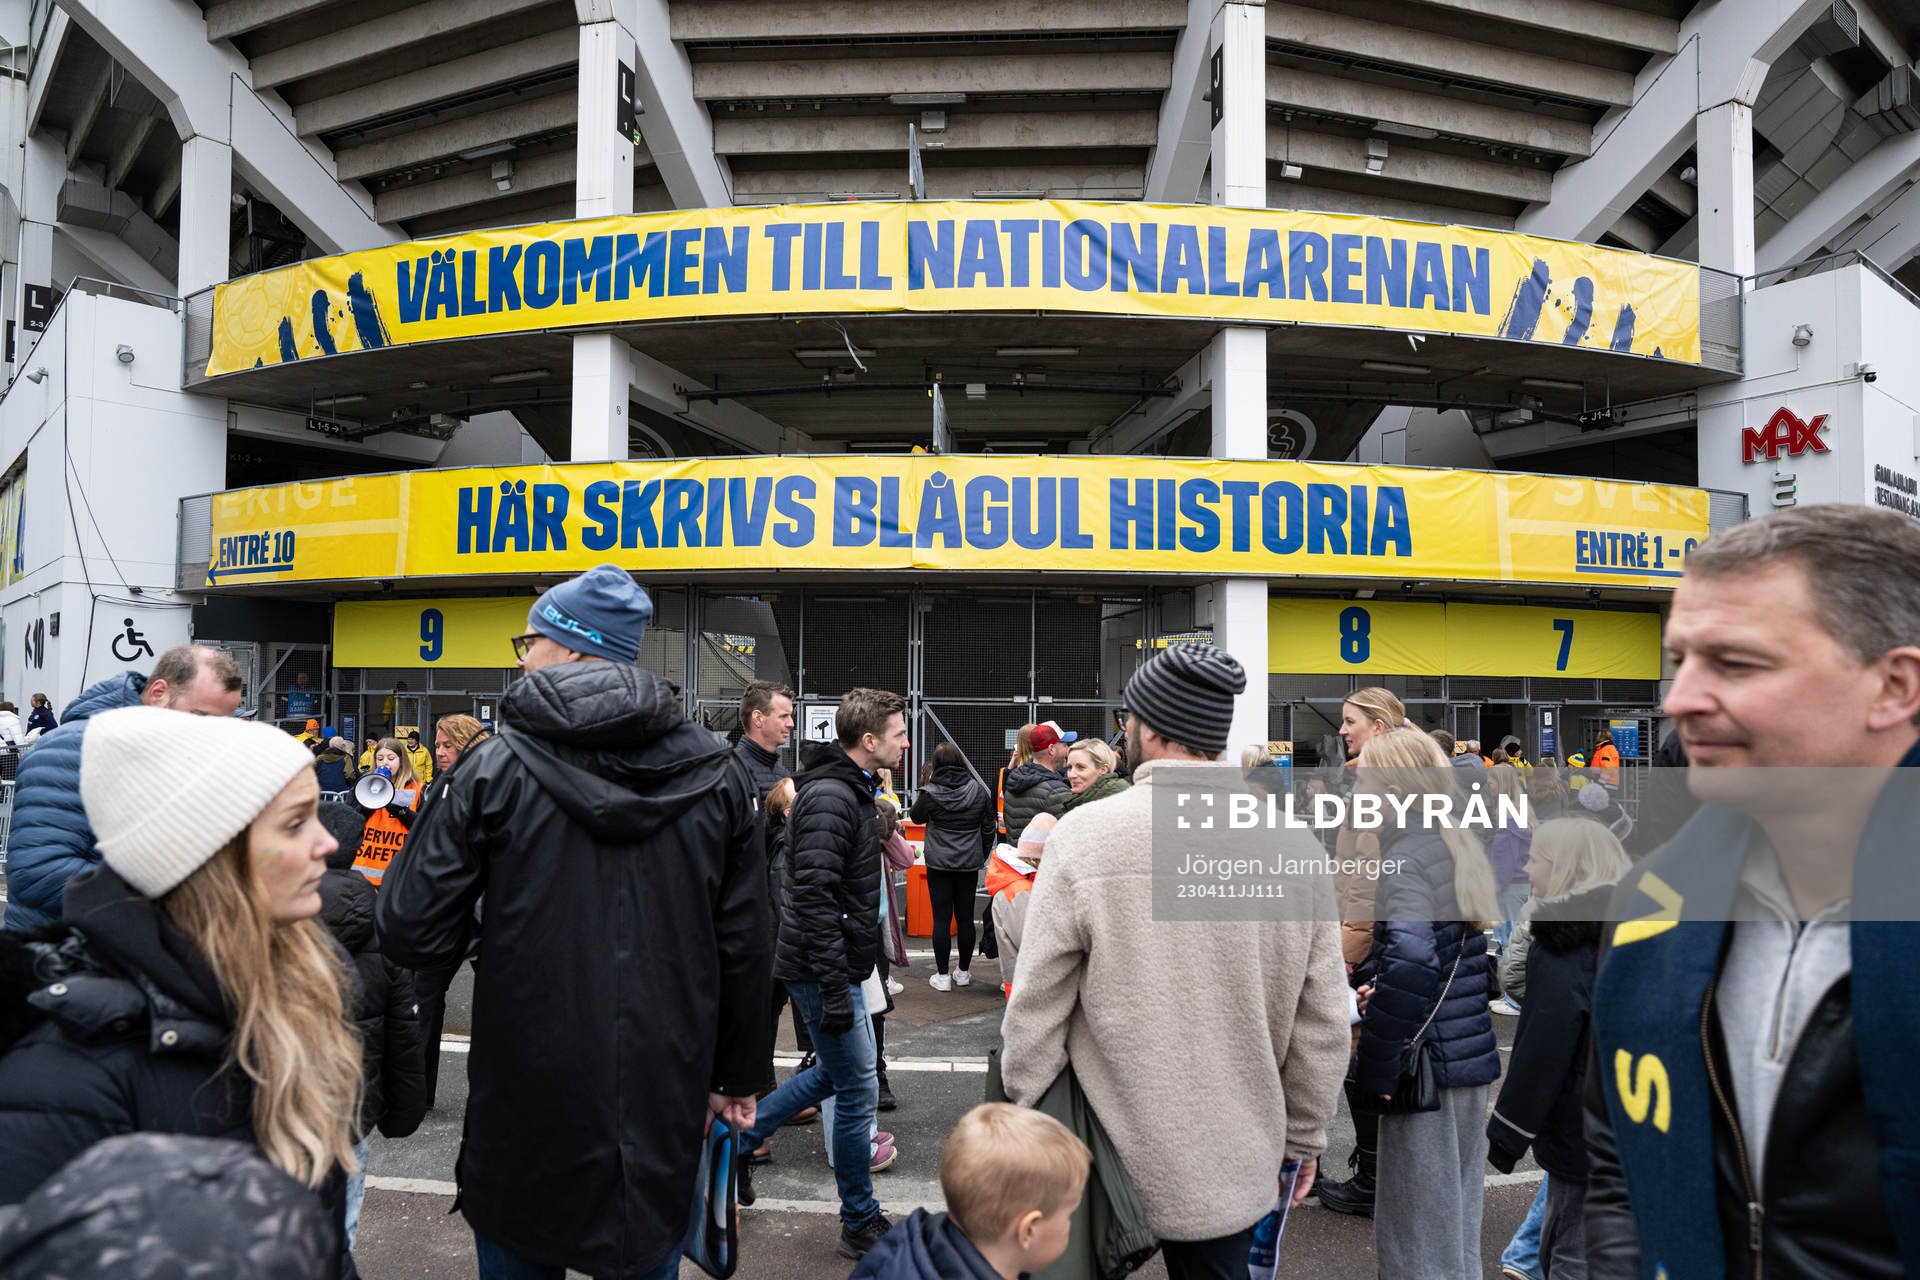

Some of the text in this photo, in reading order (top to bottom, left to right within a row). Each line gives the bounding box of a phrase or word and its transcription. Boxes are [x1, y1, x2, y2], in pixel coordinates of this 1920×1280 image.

[622, 72, 631, 104] L
[1214, 57, 1220, 89] J
[398, 220, 1490, 322] VÄLKOMMEN TILL NATIONALARENAN
[31, 290, 44, 309] L
[30, 320, 44, 328] 2-3
[1742, 406, 1830, 463] MAX
[457, 471, 1412, 557] HÄR SKRIVS BLÅGUL HISTORIA
[219, 530, 295, 567] ENTRÉ 10
[1576, 530, 1649, 568] ENTRÉ
[420, 608, 443, 661] 9
[1340, 606, 1371, 663] 8
[1553, 618, 1574, 671] 7
[364, 827, 408, 846] ERVIC
